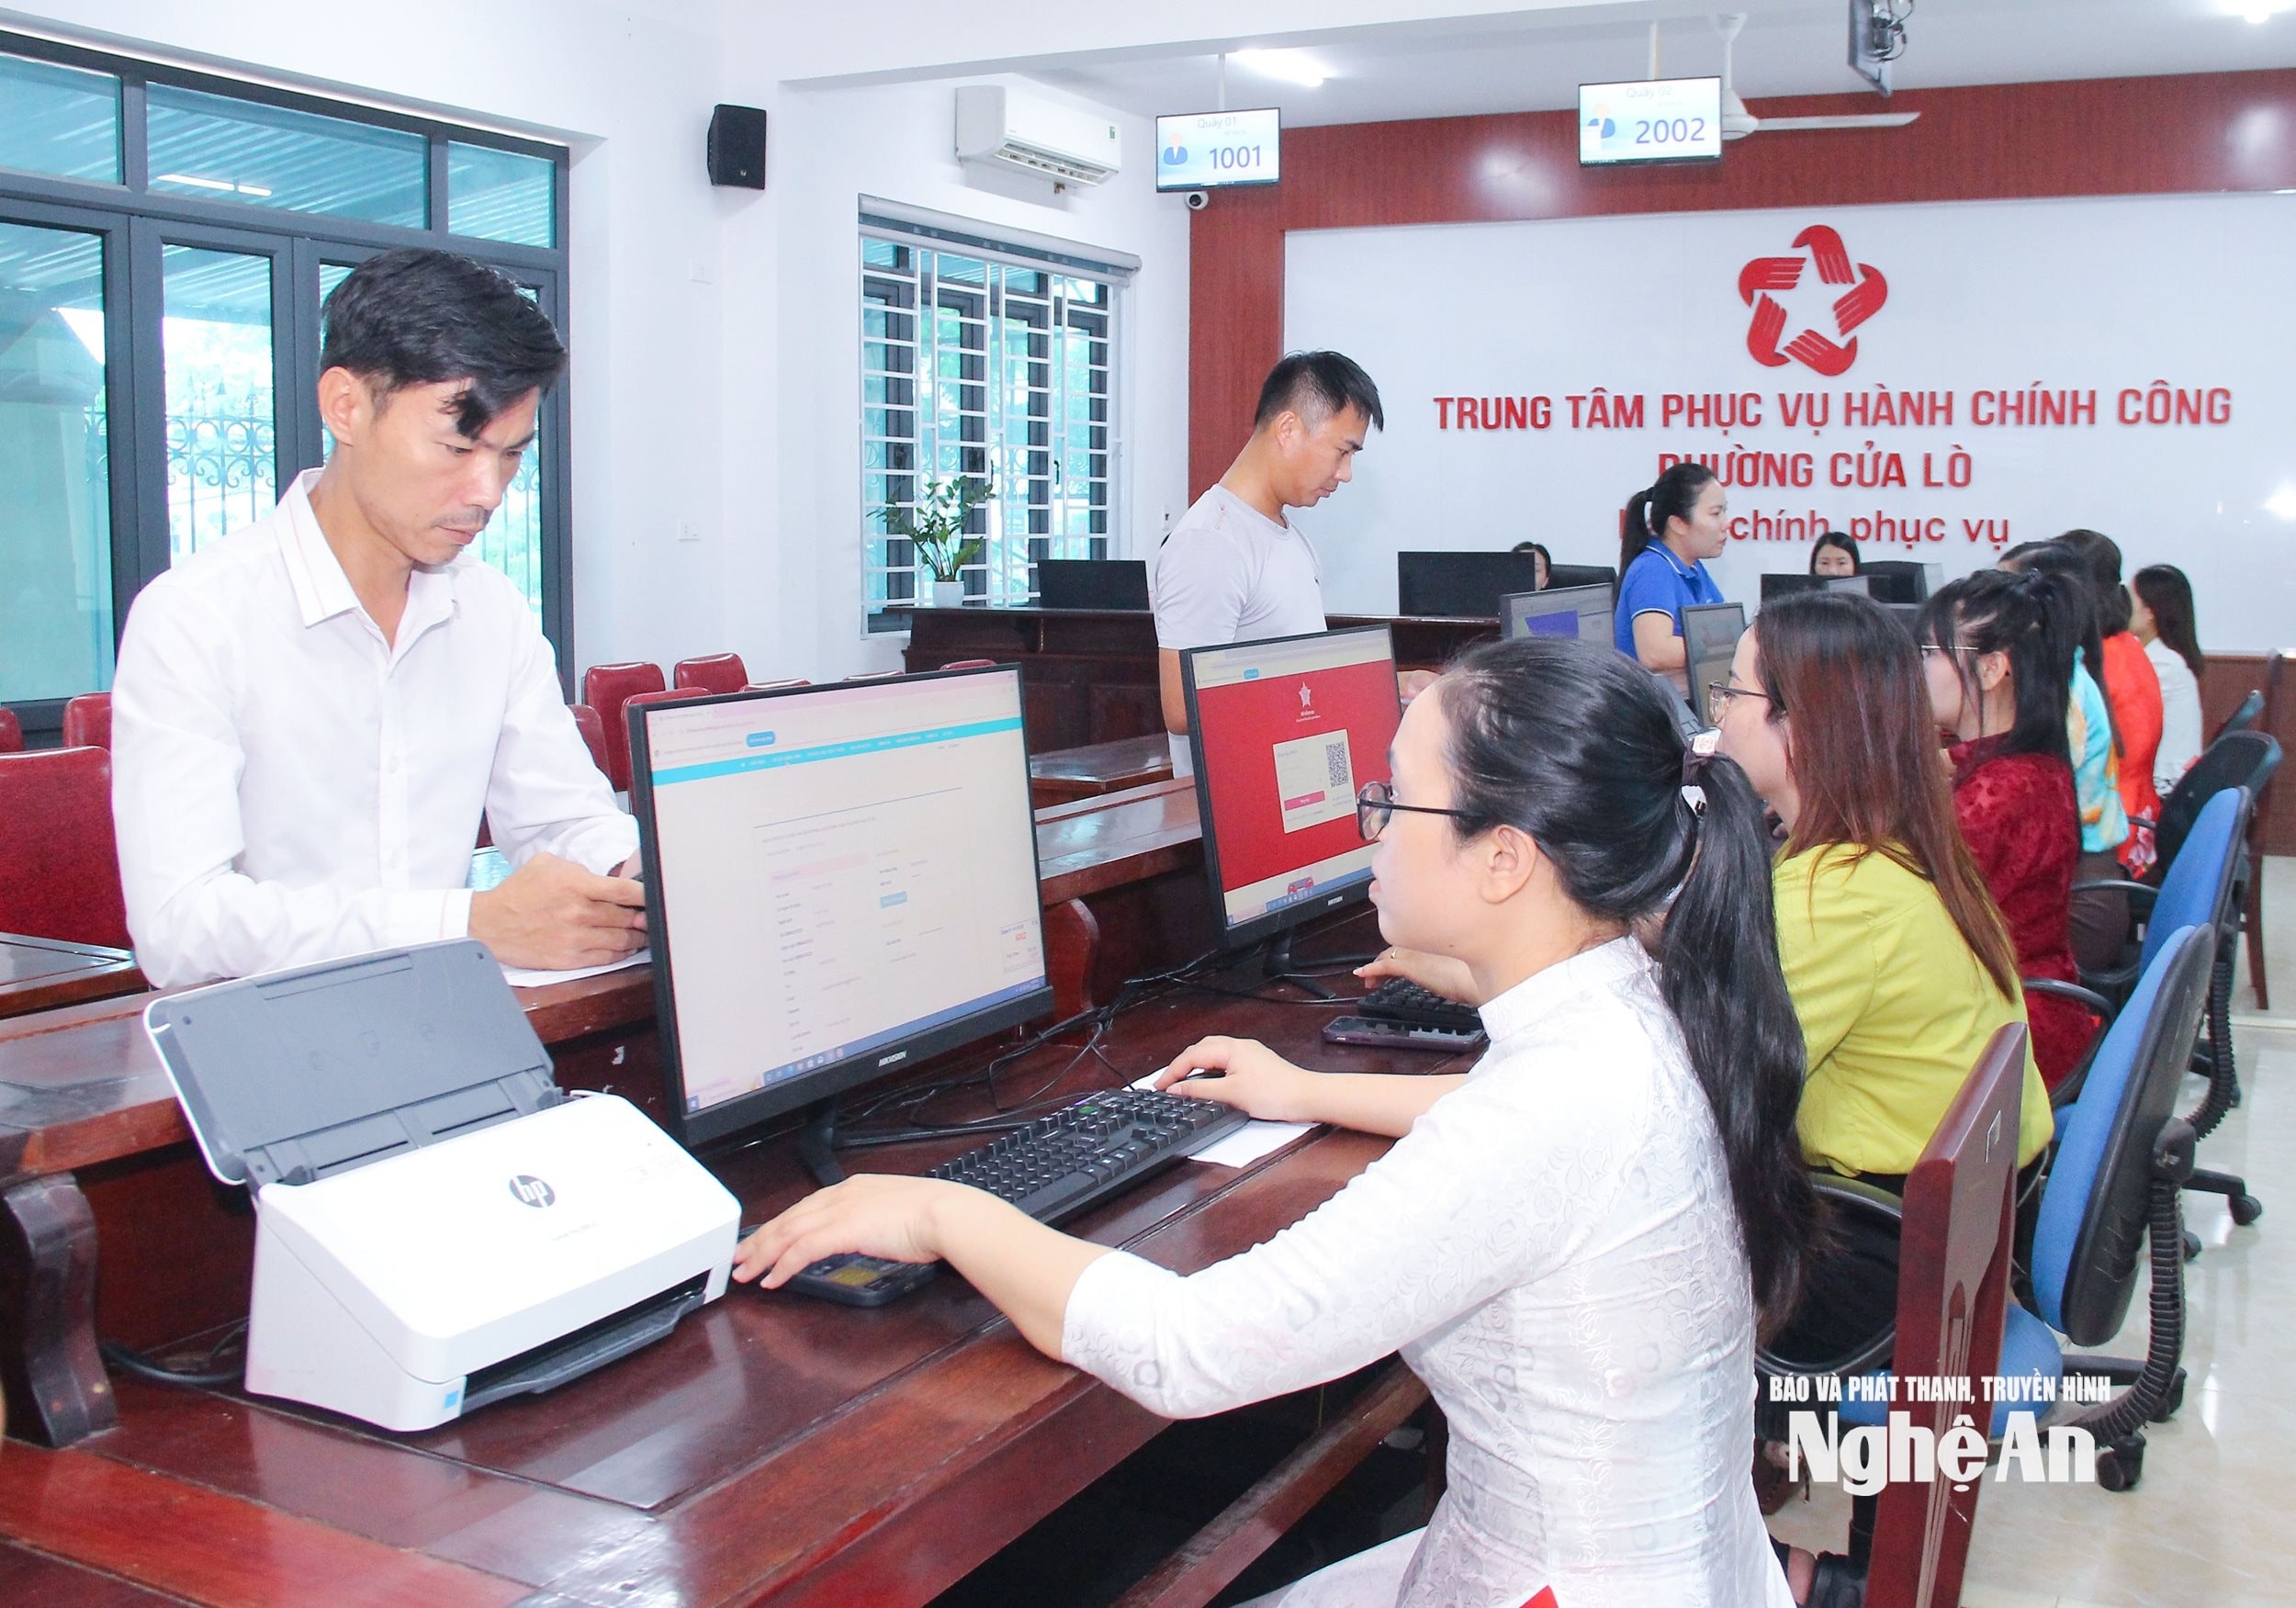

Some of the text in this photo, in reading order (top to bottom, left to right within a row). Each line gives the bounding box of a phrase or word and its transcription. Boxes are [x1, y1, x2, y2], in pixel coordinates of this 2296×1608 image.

[1636, 118, 1705, 144] 2002
[1209, 145, 1260, 169] 1001
[1434, 379, 2232, 436] TRUNG TÂM PHỤC VỤ HÀNH CHÍNH CÔNG
[1829, 440, 1908, 489] CỬA
[1923, 444, 1972, 489] LÒ
[1729, 510, 2009, 551] chính phục vụ
